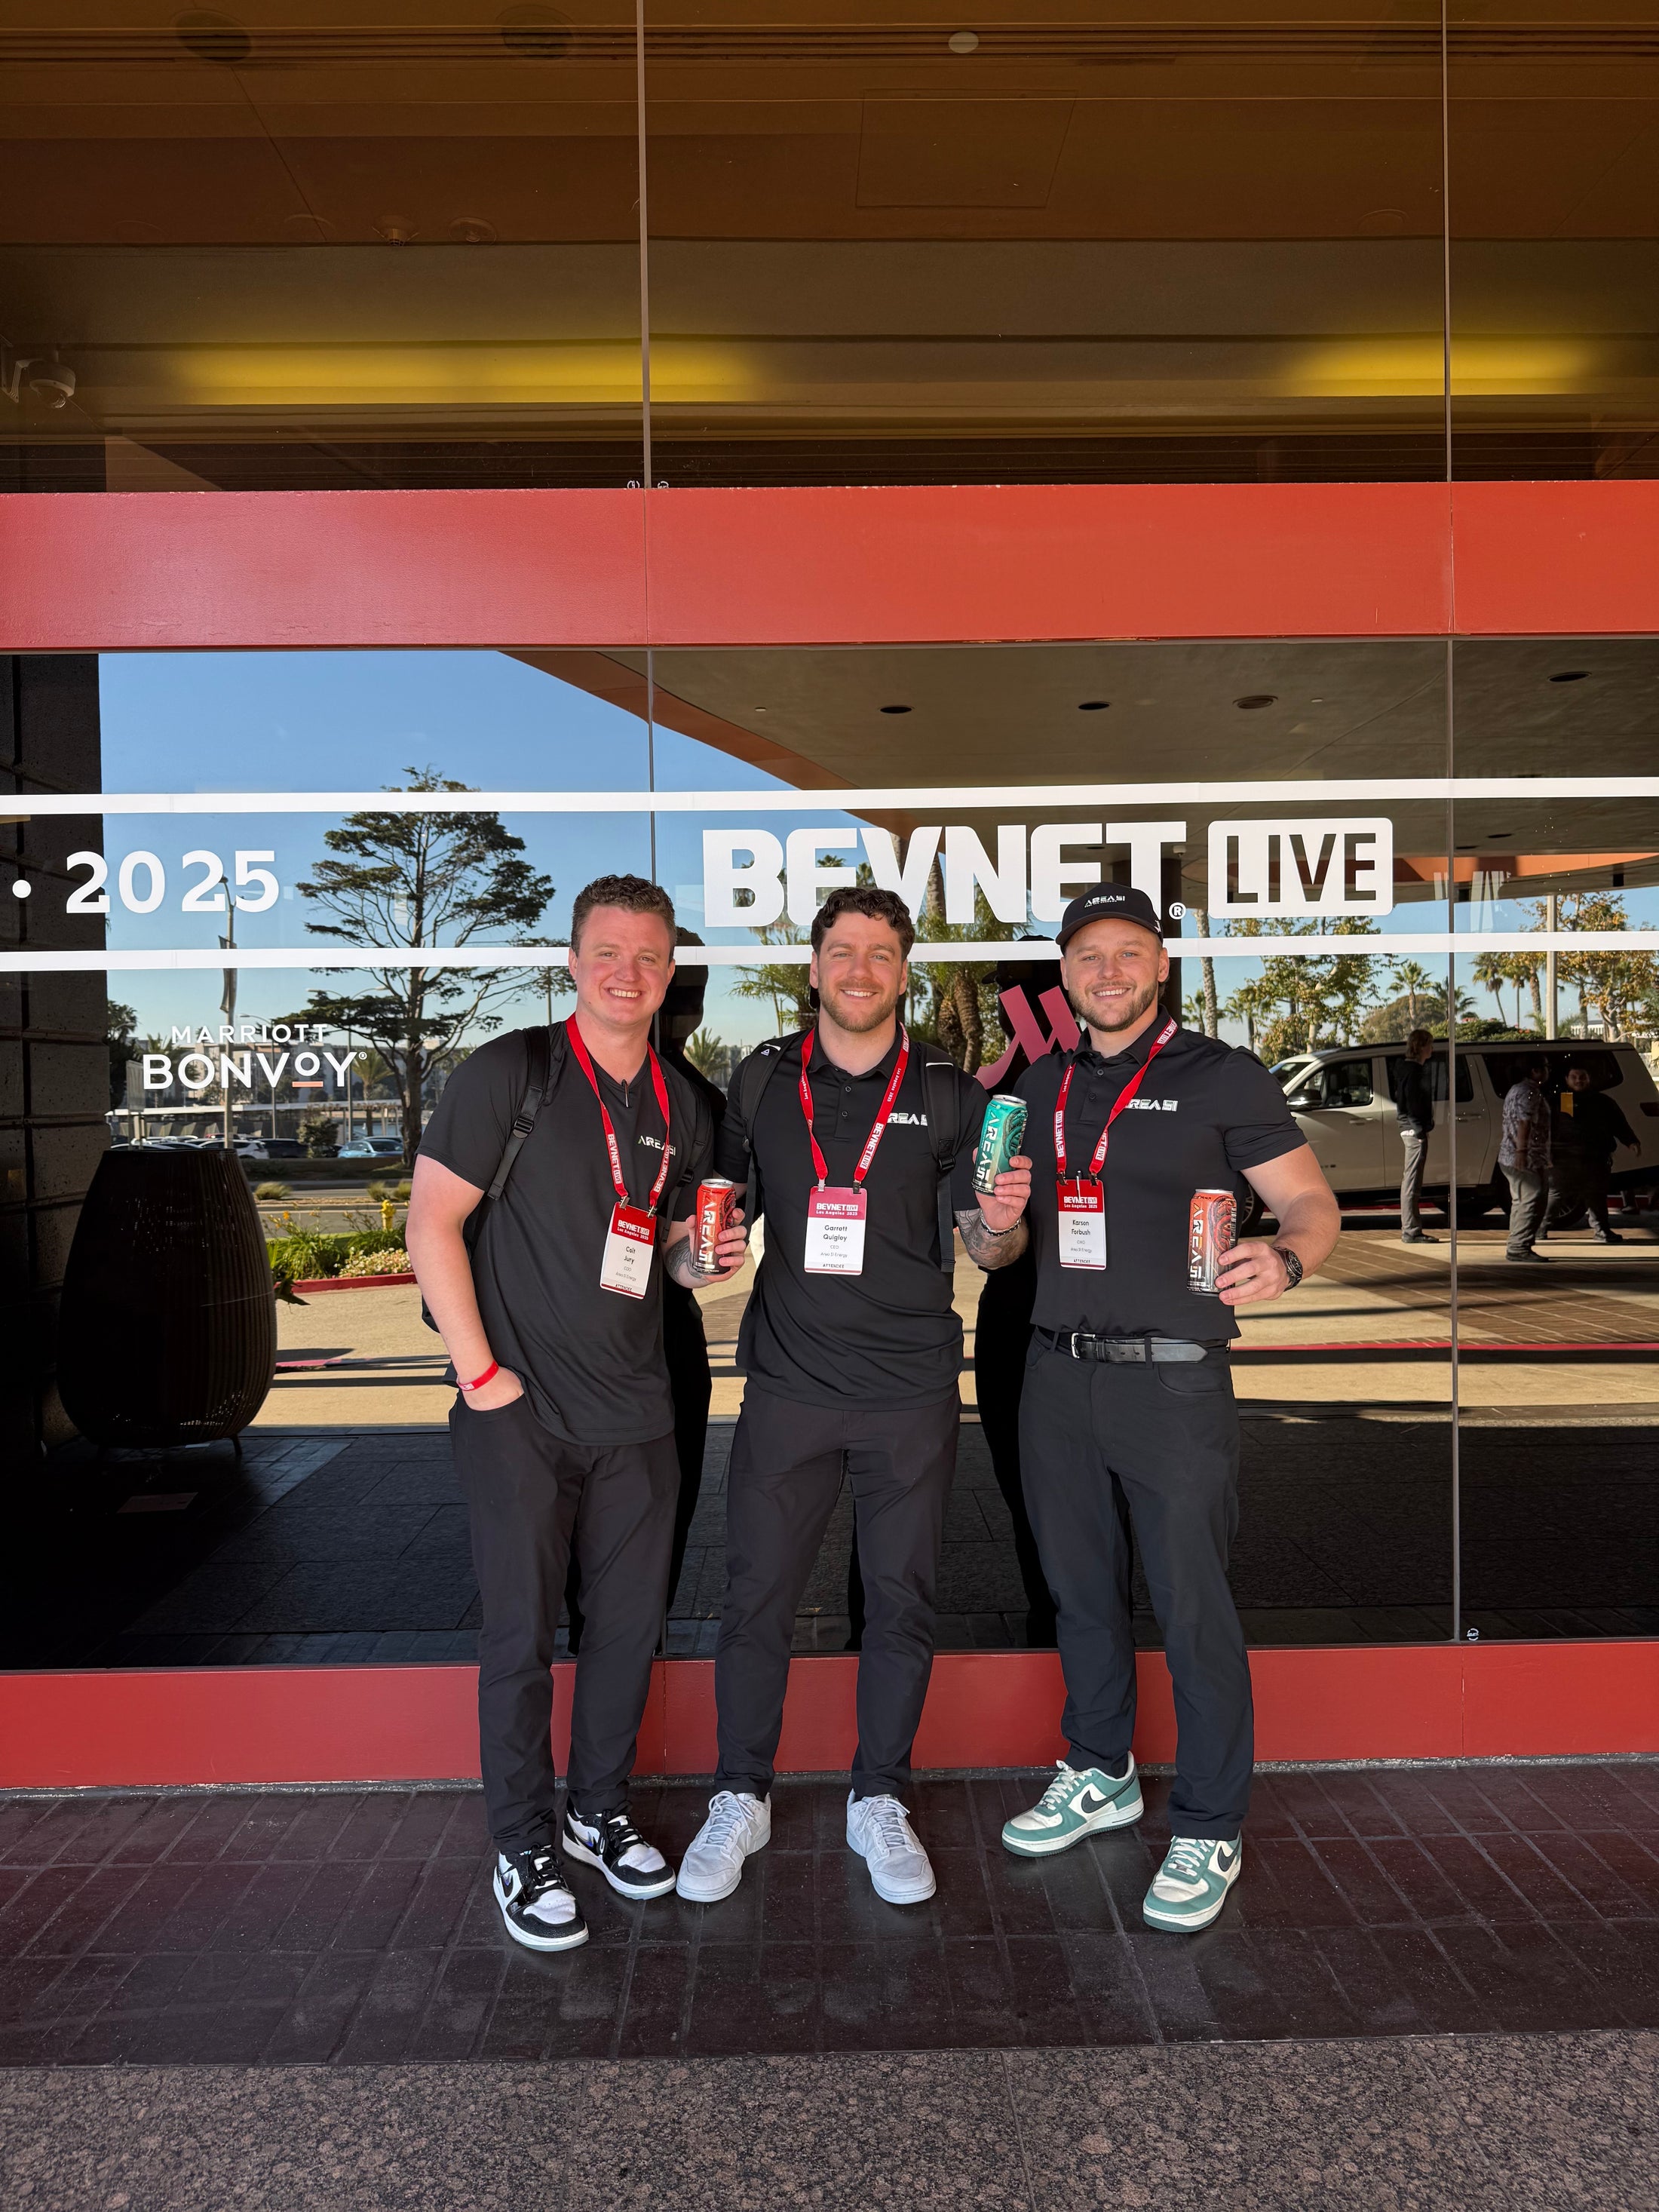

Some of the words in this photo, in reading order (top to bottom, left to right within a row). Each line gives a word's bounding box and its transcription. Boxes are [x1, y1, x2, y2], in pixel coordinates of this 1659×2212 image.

[1225, 832, 1377, 904] LIVE
[66, 850, 280, 914] 2025
[171, 1023, 328, 1044] MARRIOTT
[865, 1122, 884, 1156] BEVNET
[1056, 1123, 1065, 1158] BEVNET
[608, 1134, 620, 1170] BEVNET
[614, 1170, 622, 1185] LIVE
[817, 1203, 847, 1211] BEVNET
[1064, 1196, 1088, 1204] BEVNET
[618, 1220, 642, 1233] BEVNET
[624, 1229, 639, 1238] Angeles
[626, 1246, 636, 1254] Colt
[624, 1256, 635, 1265] Jury
